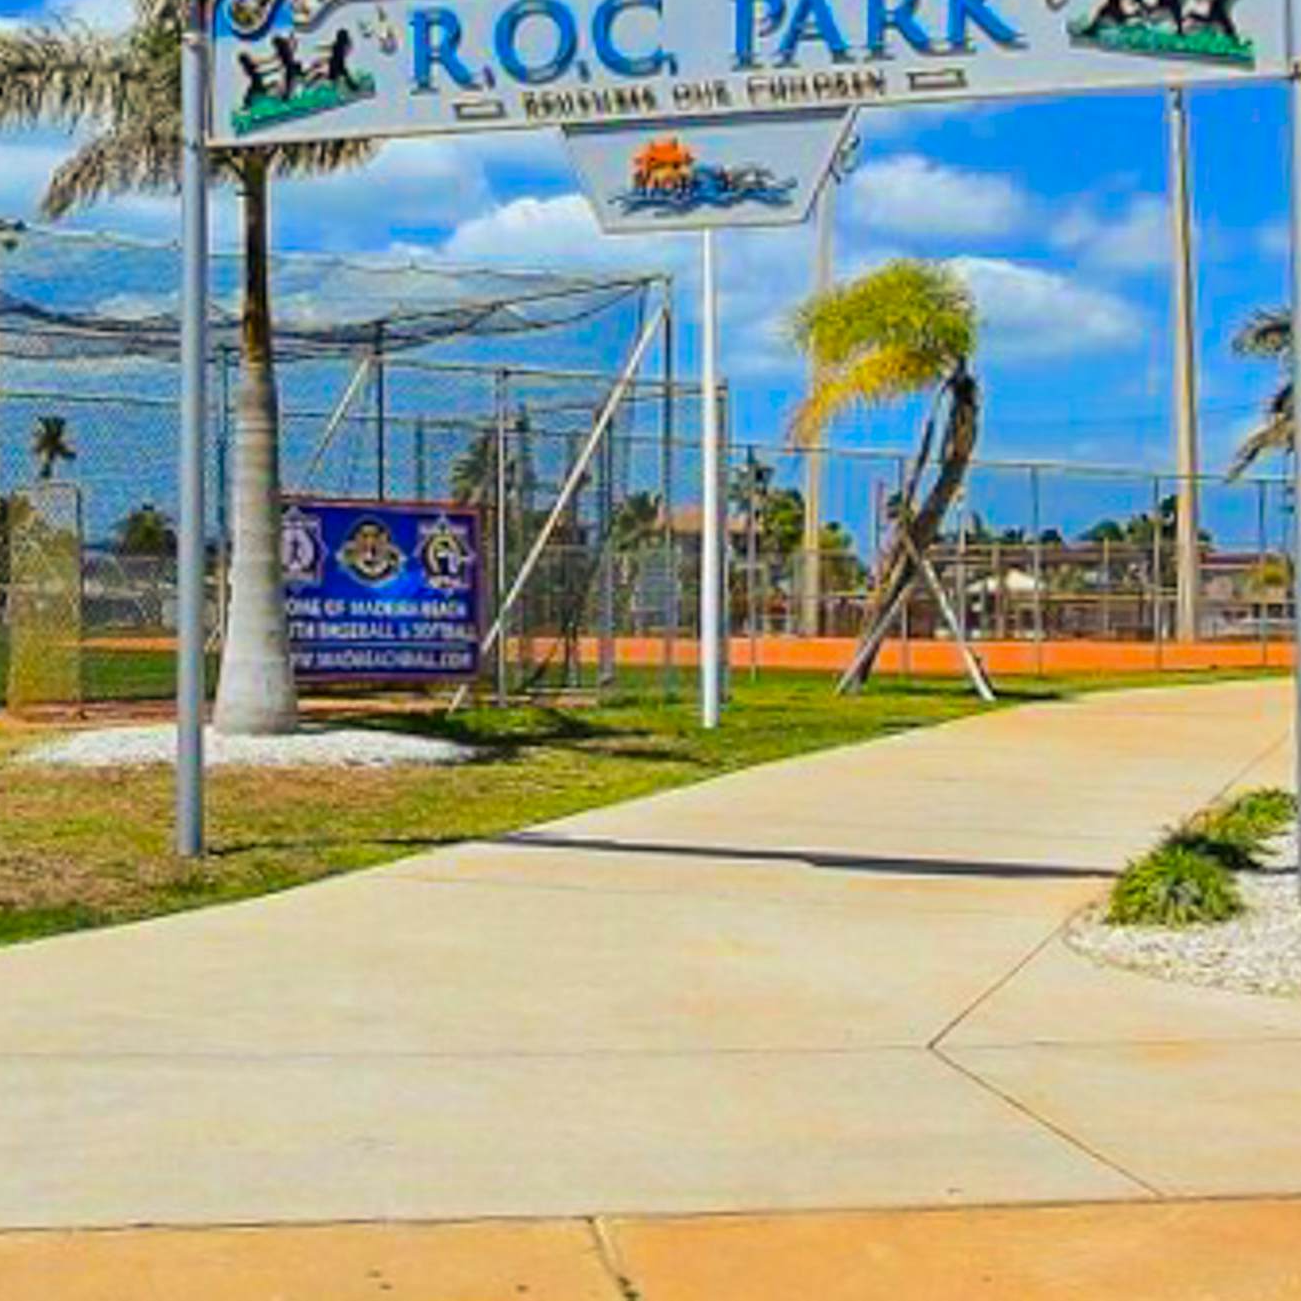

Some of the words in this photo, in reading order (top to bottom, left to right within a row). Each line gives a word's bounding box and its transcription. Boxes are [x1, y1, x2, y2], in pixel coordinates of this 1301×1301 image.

[286, 599, 321, 617] OME
[324, 599, 345, 617] OF
[421, 600, 467, 619] BEACH
[320, 621, 395, 639] BASEBALL
[412, 622, 478, 640] SOFTBALL
